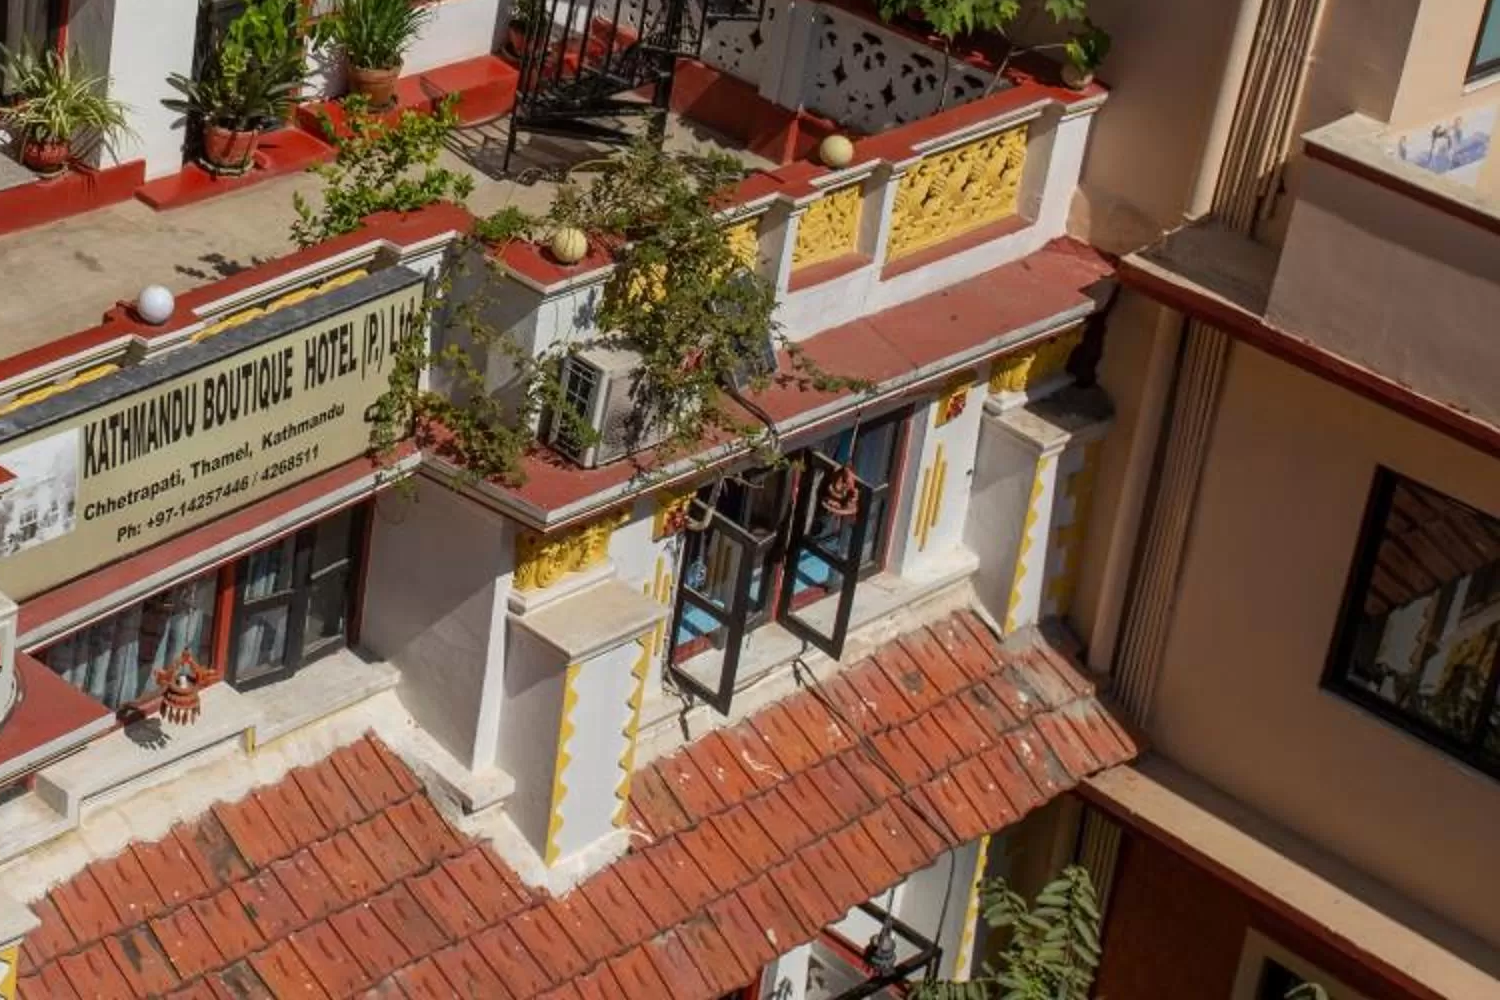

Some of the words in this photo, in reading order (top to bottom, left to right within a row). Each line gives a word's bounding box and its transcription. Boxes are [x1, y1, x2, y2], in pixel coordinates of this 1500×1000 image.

[84, 384, 197, 479] KATHMANDU
[202, 346, 293, 431] BOUTIQUE
[304, 321, 357, 391] HOTEL
[83, 469, 185, 521] Chhetrapati,
[190, 442, 253, 479] Thamel,
[262, 402, 345, 450] Kathmandu
[117, 523, 142, 543] Ph:
[260, 443, 319, 481] 4268511
